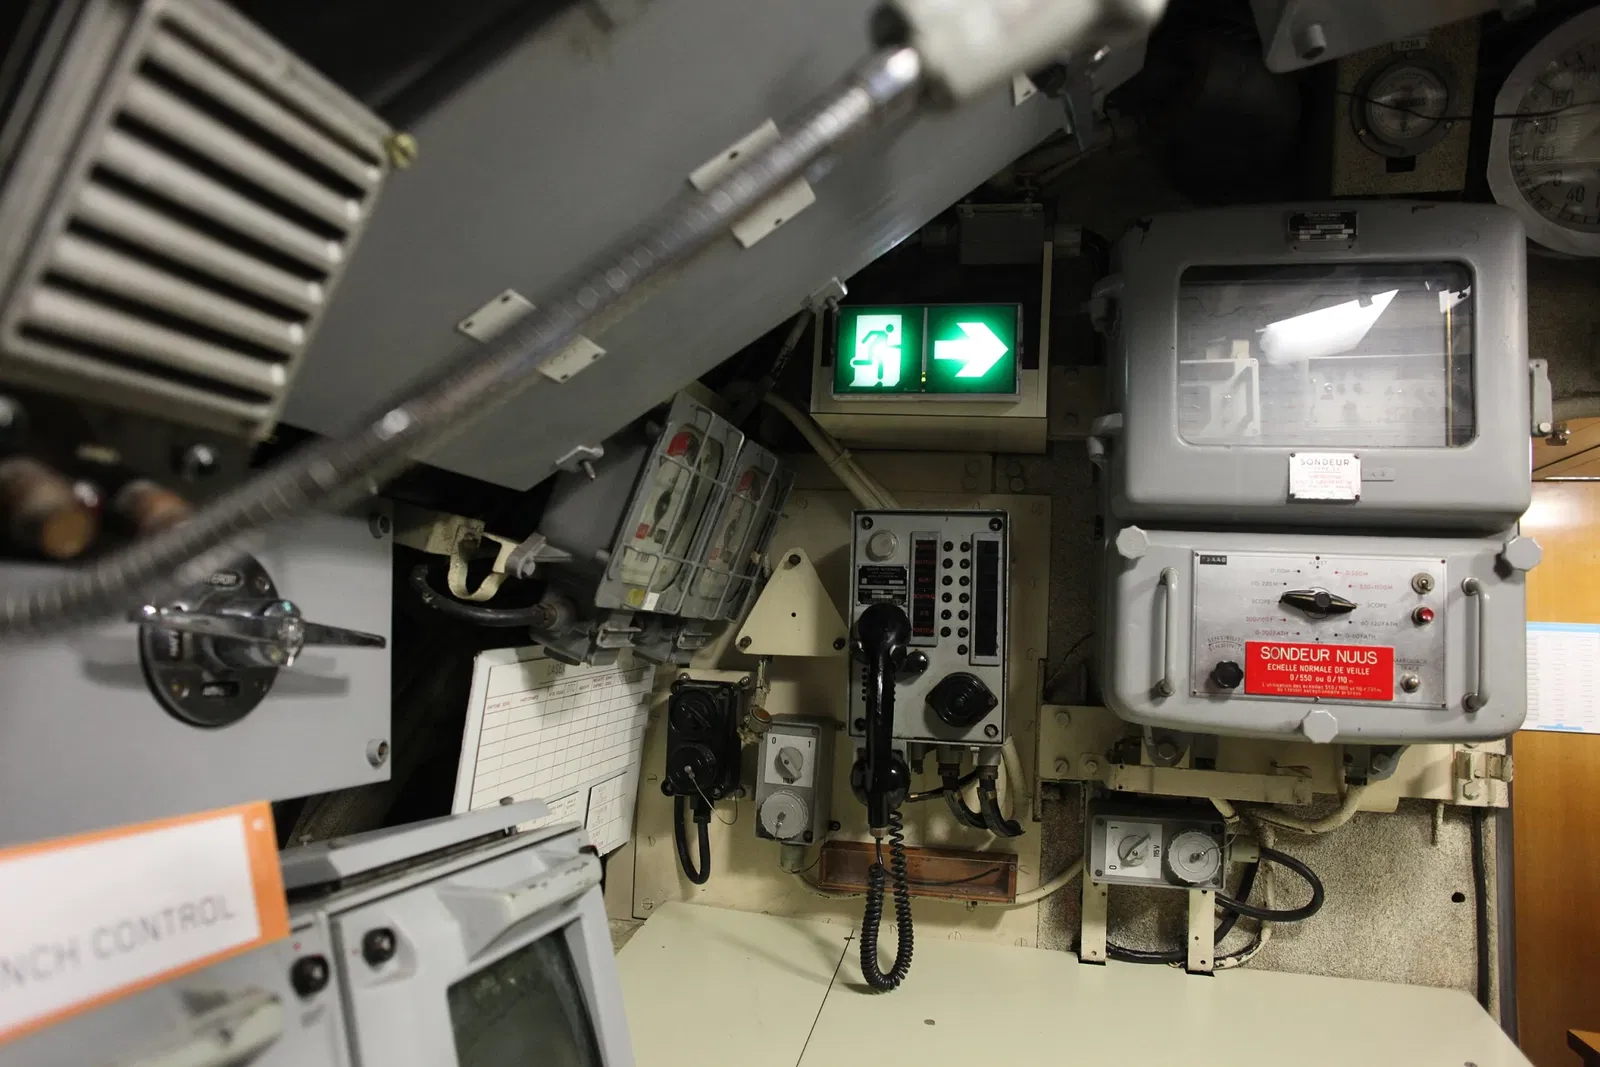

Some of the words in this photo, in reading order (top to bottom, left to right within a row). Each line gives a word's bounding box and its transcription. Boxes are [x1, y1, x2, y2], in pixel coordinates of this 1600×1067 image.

[1300, 458, 1350, 466] SONDEUR
[1260, 646, 1330, 661] SONDEUR
[1336, 649, 1378, 665] NUUS
[1267, 663, 1298, 671] ECHELLE
[1299, 664, 1332, 673] NORMALE
[1335, 666, 1344, 674] DE
[1346, 666, 1370, 675] VEILLE
[771, 736, 777, 744] 0
[91, 895, 235, 960] CONTROL
